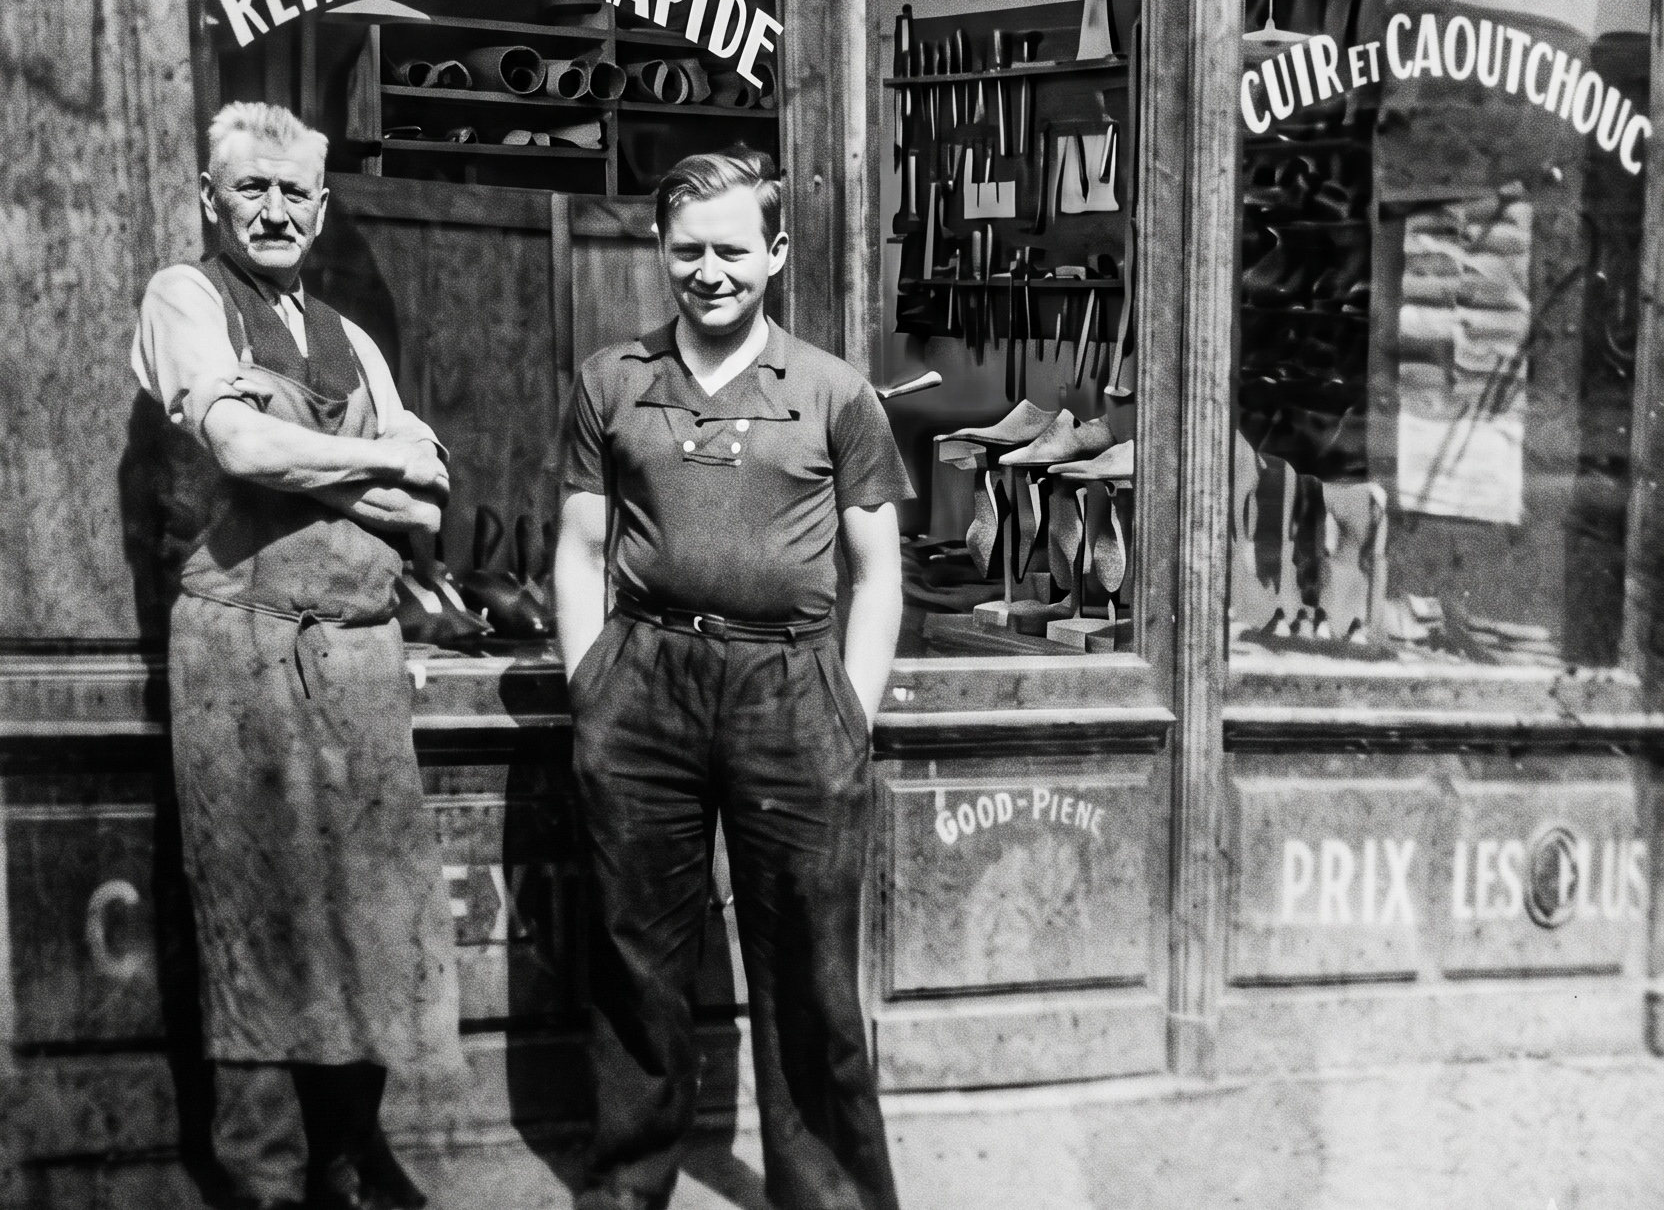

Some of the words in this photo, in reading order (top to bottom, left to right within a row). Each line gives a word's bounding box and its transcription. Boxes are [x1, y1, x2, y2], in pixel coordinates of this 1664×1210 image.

[1240, 34, 1344, 134] CUIR
[1347, 40, 1381, 89] ET
[1386, 13, 1653, 176] CAOUTCHOUC
[1282, 837, 1417, 925] PRIX
[1451, 839, 1528, 921] LES
